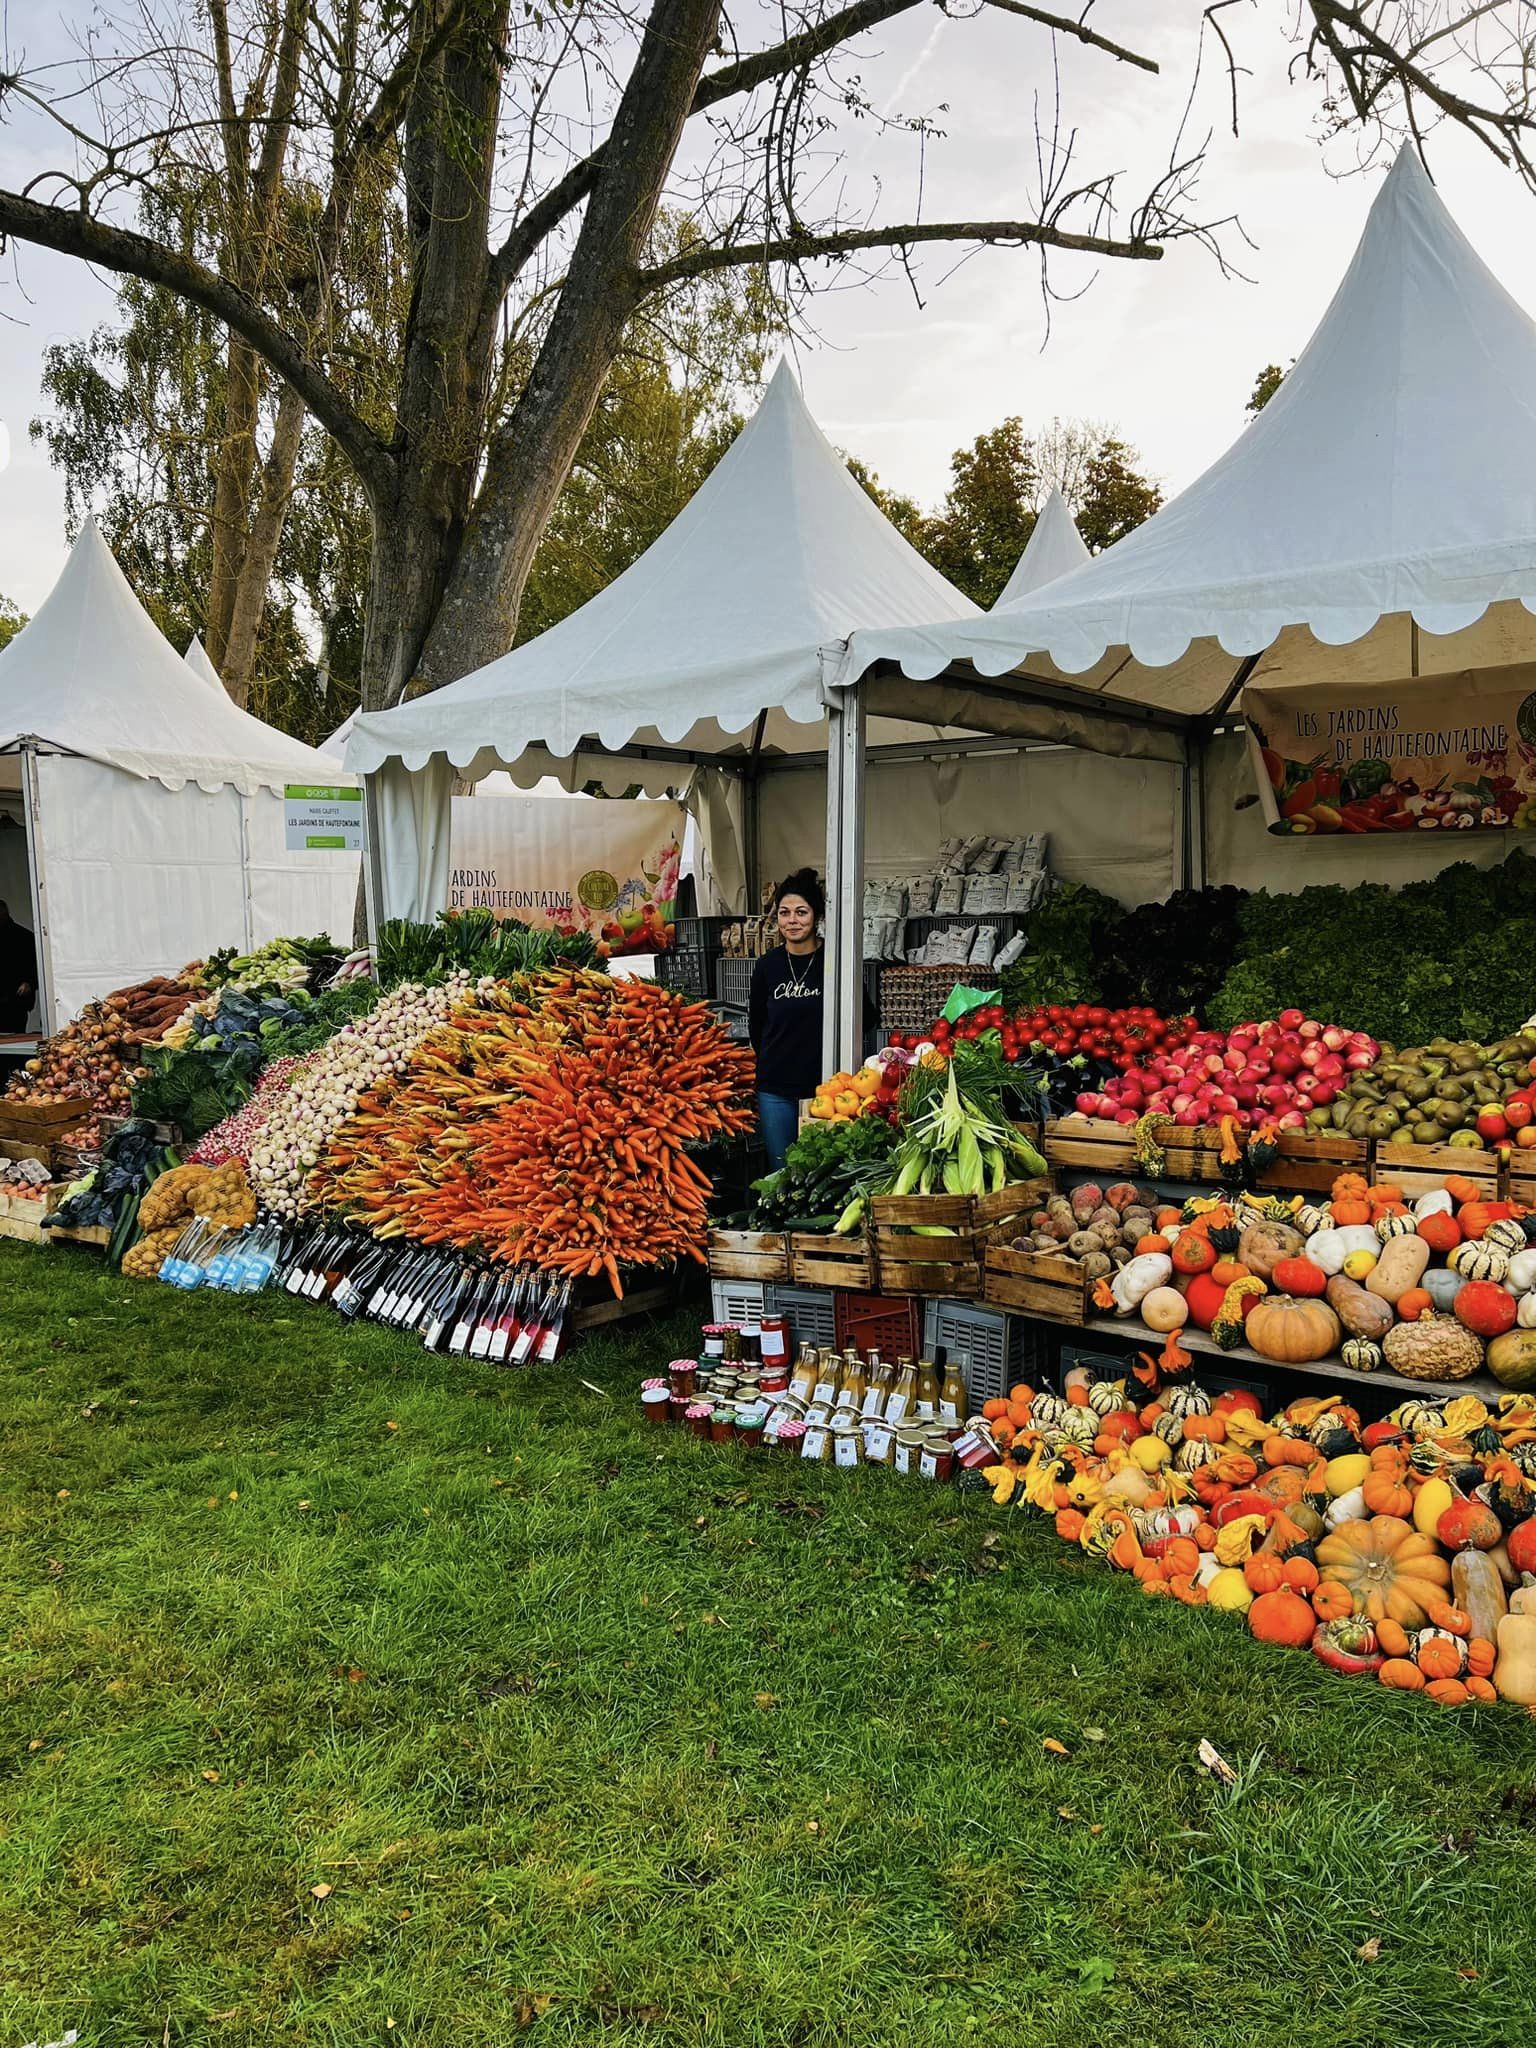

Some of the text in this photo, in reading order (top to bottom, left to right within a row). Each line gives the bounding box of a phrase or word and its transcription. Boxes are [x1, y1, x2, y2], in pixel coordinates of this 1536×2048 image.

[1295, 705, 1400, 738] LES JARDINS
[1335, 724, 1506, 761] DE HAUTEFONTAINE
[298, 818, 318, 828] JARDINS
[325, 819, 361, 828] HAUTEFONTAINE
[451, 869, 497, 888] ARDINS
[451, 889, 465, 908] DE
[472, 889, 572, 909] HAUTEFONTAINE
